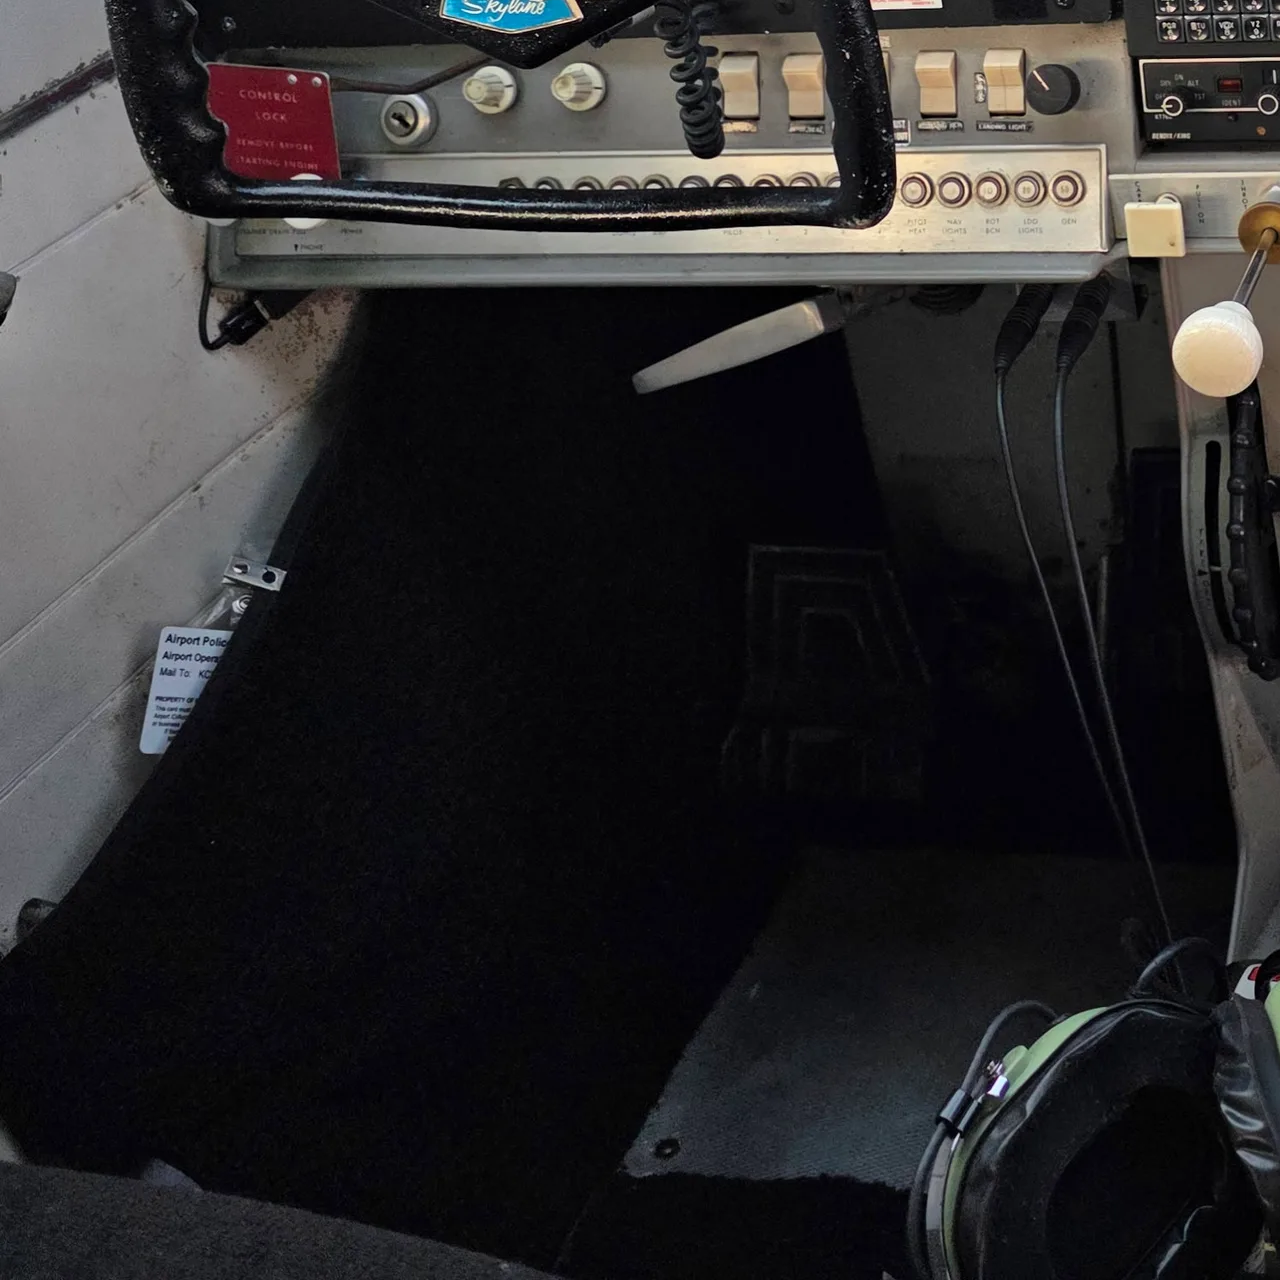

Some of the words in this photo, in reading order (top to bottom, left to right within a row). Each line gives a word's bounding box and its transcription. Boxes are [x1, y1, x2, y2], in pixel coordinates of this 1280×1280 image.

[1187, 79, 1199, 87] ALT
[239, 90, 297, 103] CONTROL
[1222, 99, 1242, 107] IDENT
[256, 112, 287, 121] LOCK
[165, 634, 201, 646] Airport
[162, 651, 192, 661] Airport
[159, 667, 176, 676] Mail
[178, 668, 191, 677] To:
